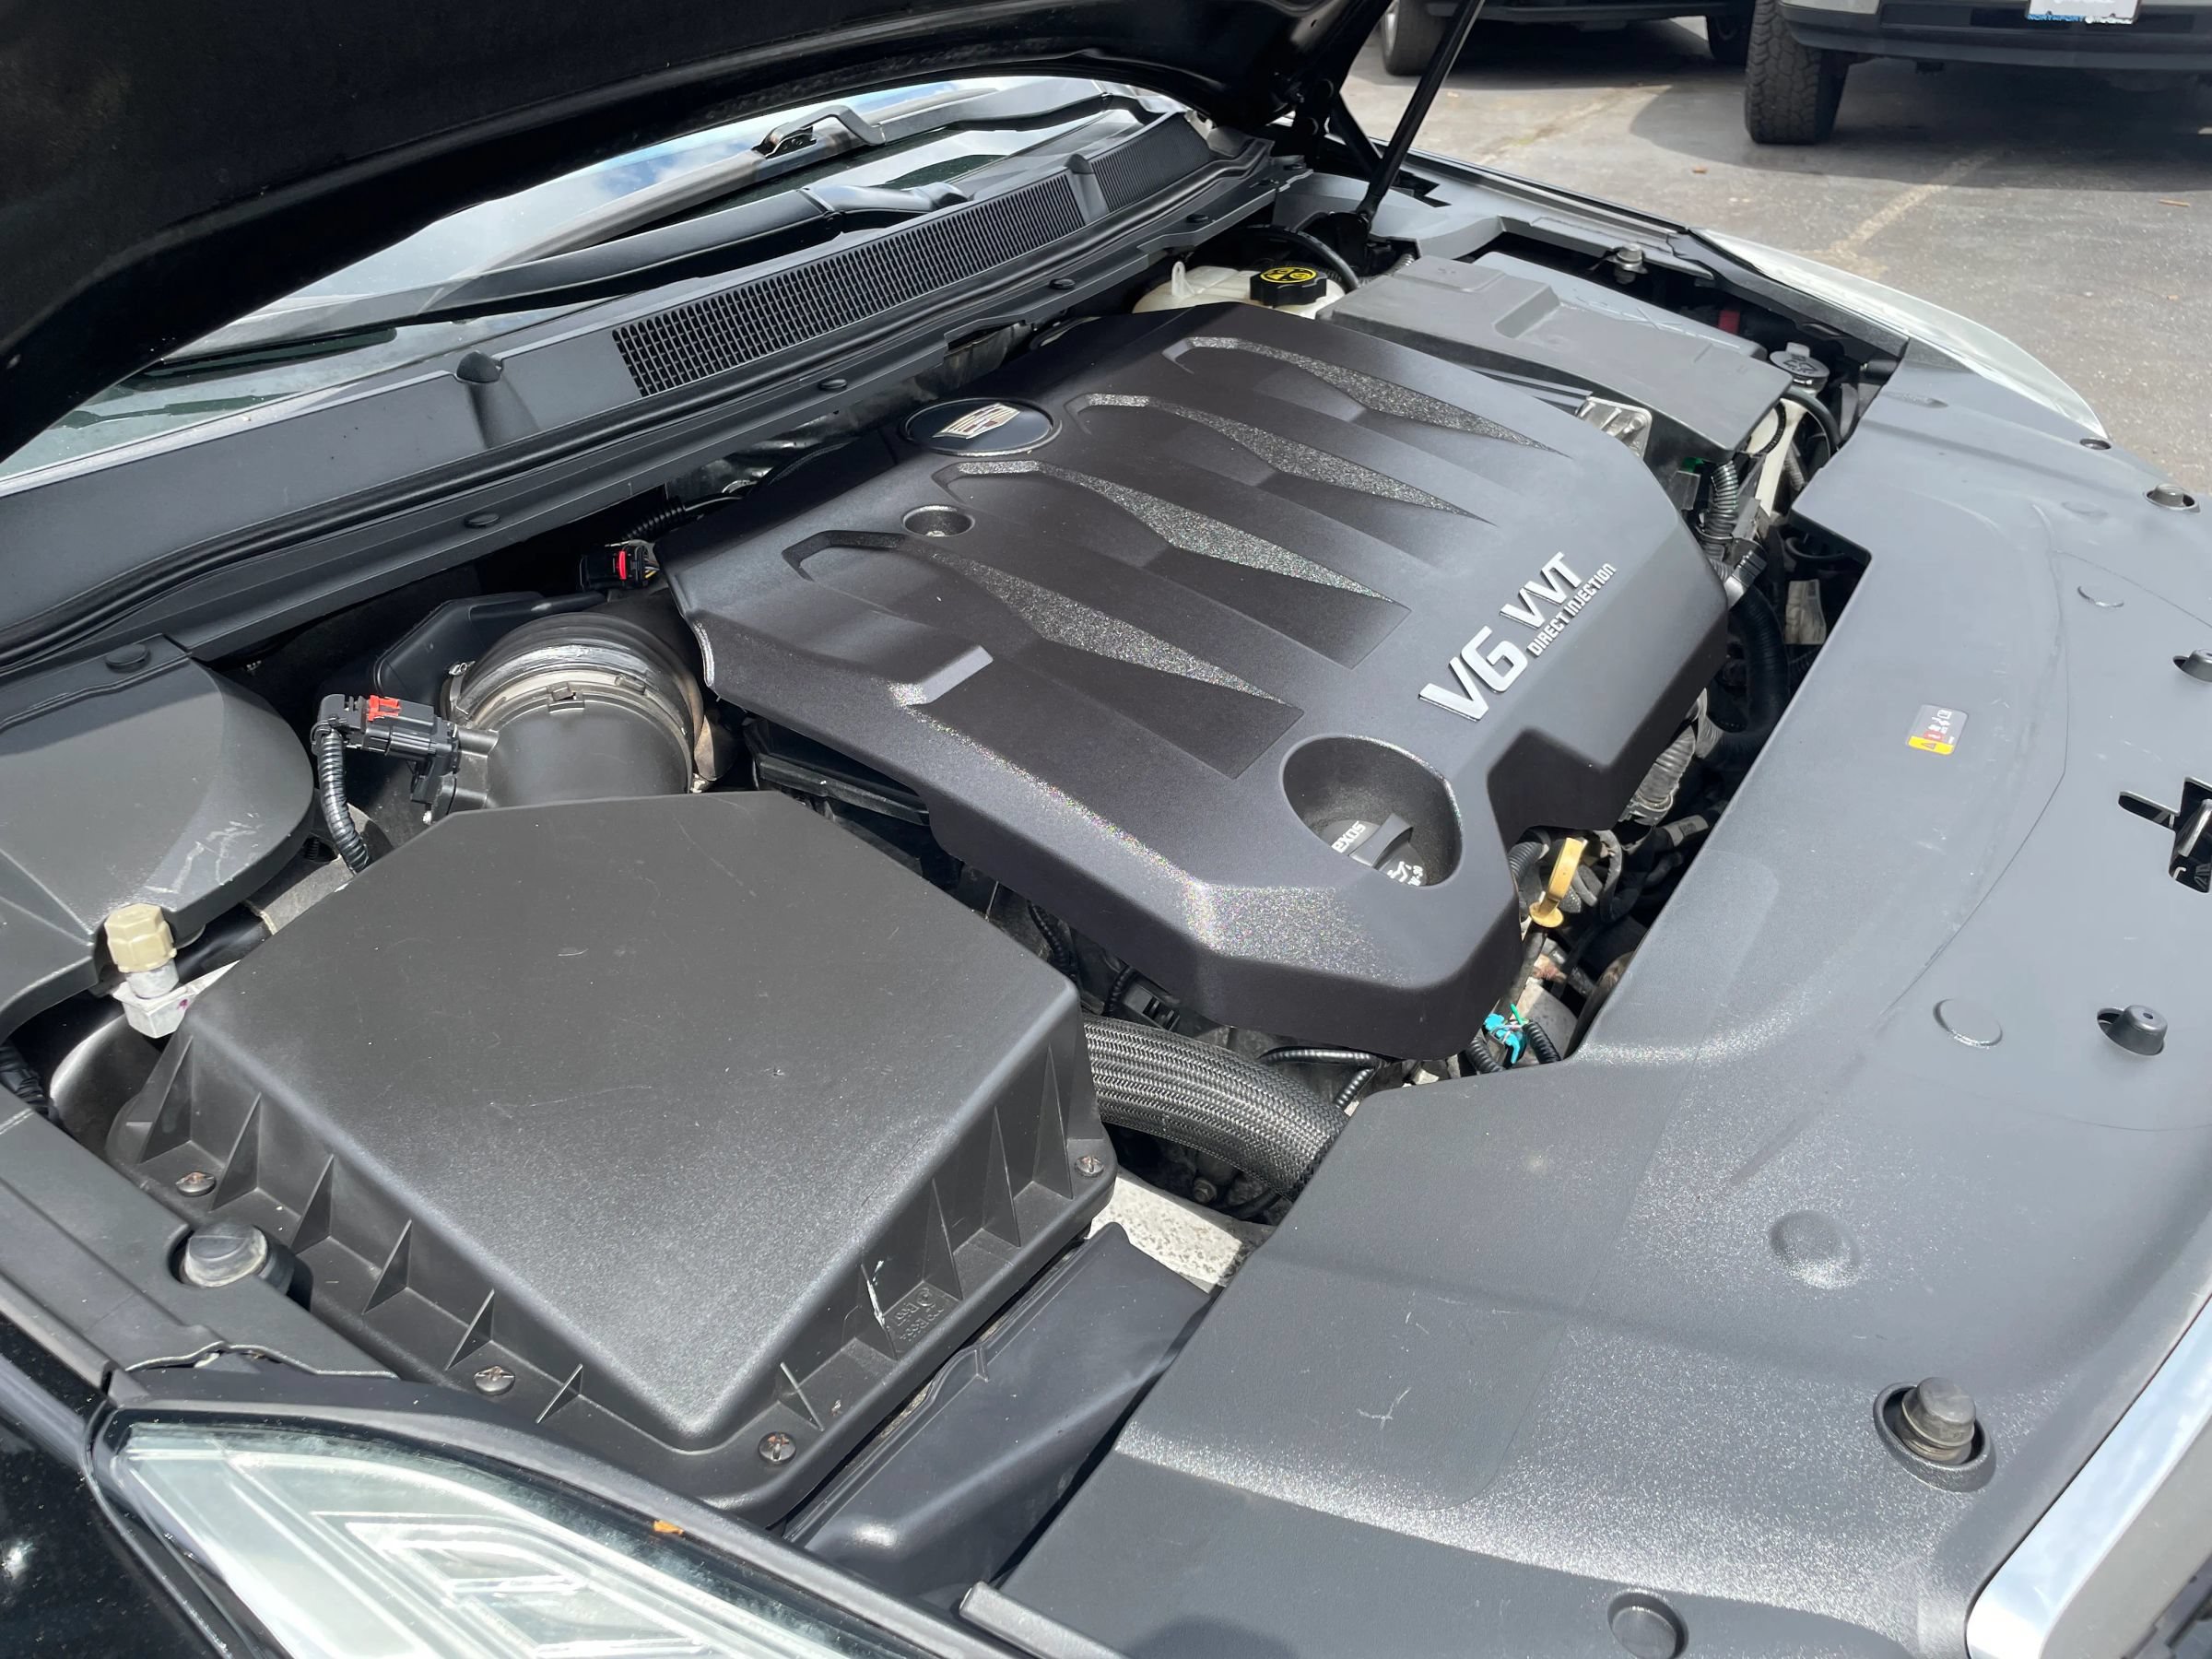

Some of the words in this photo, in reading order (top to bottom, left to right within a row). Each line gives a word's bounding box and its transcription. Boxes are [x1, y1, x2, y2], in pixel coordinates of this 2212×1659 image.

[1418, 626, 1528, 722] V6
[1500, 552, 1583, 629] VVT
[1527, 608, 1570, 657] DIRECT
[1566, 563, 1617, 617] INJECTION
